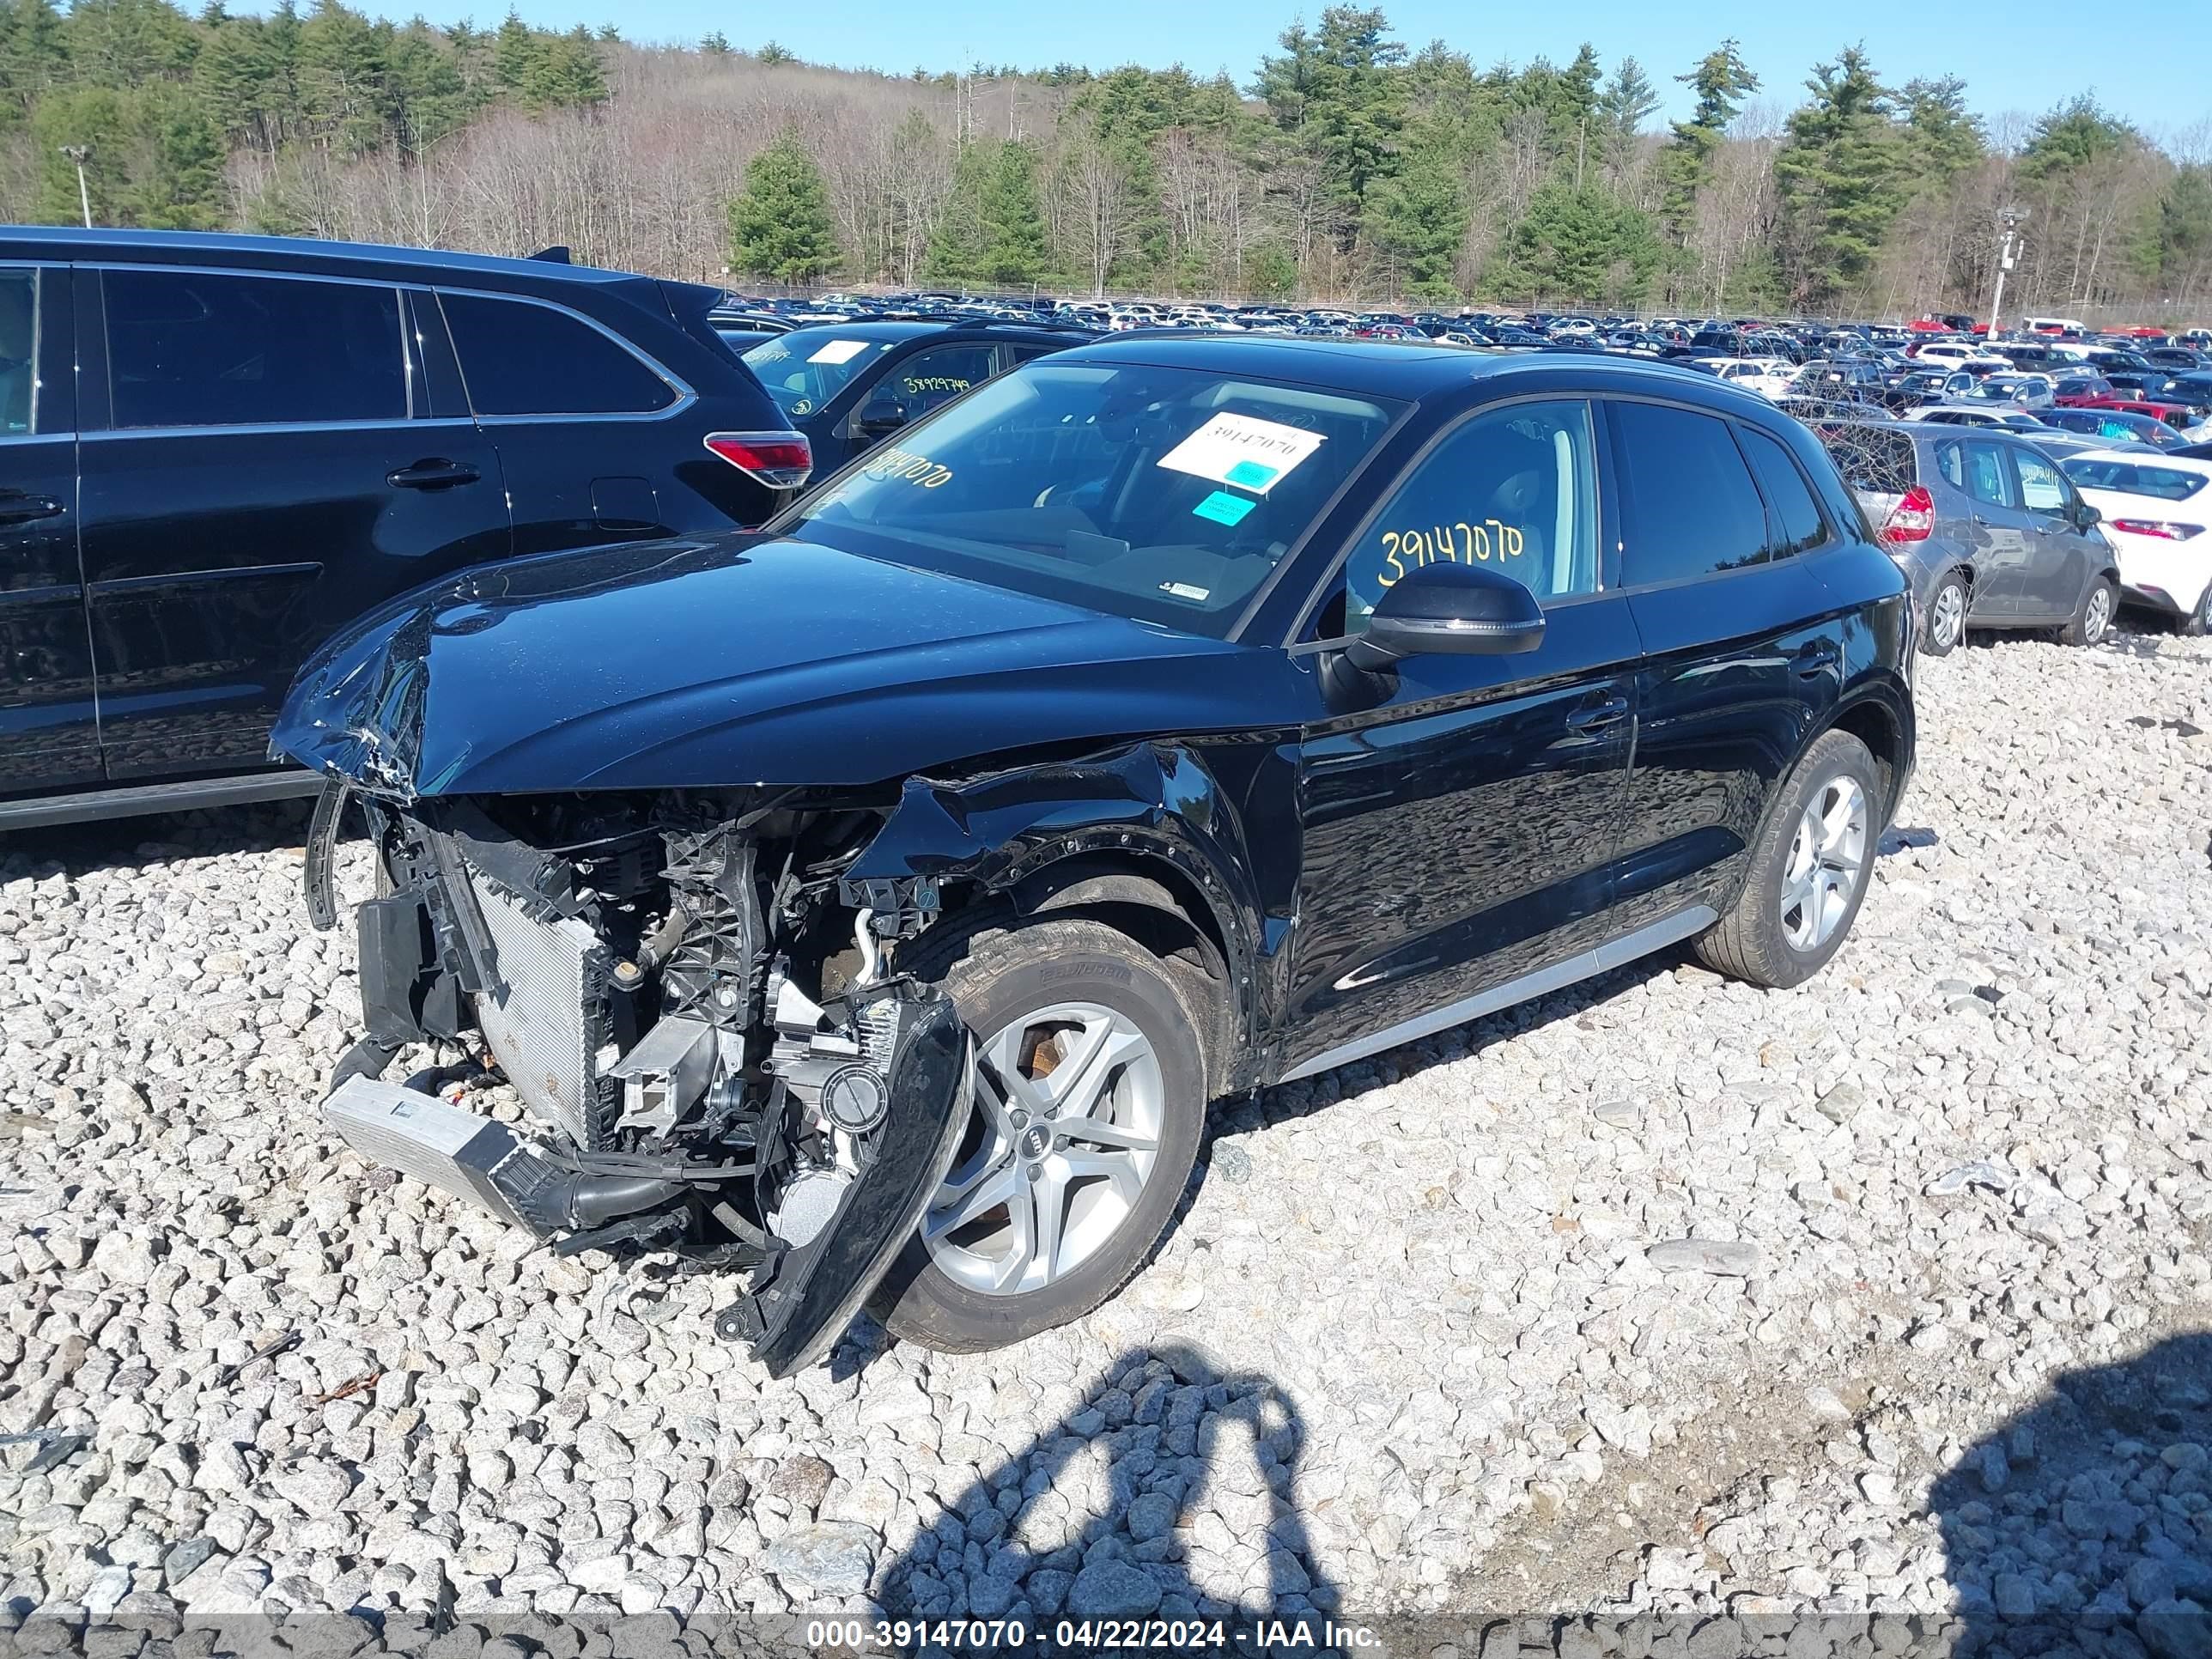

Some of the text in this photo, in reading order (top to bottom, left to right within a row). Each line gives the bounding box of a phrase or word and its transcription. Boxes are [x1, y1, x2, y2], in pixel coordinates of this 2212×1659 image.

[903, 377, 970, 393] 38929749
[1206, 427, 1297, 455] 39147070
[1376, 519, 1525, 586] 39147070
